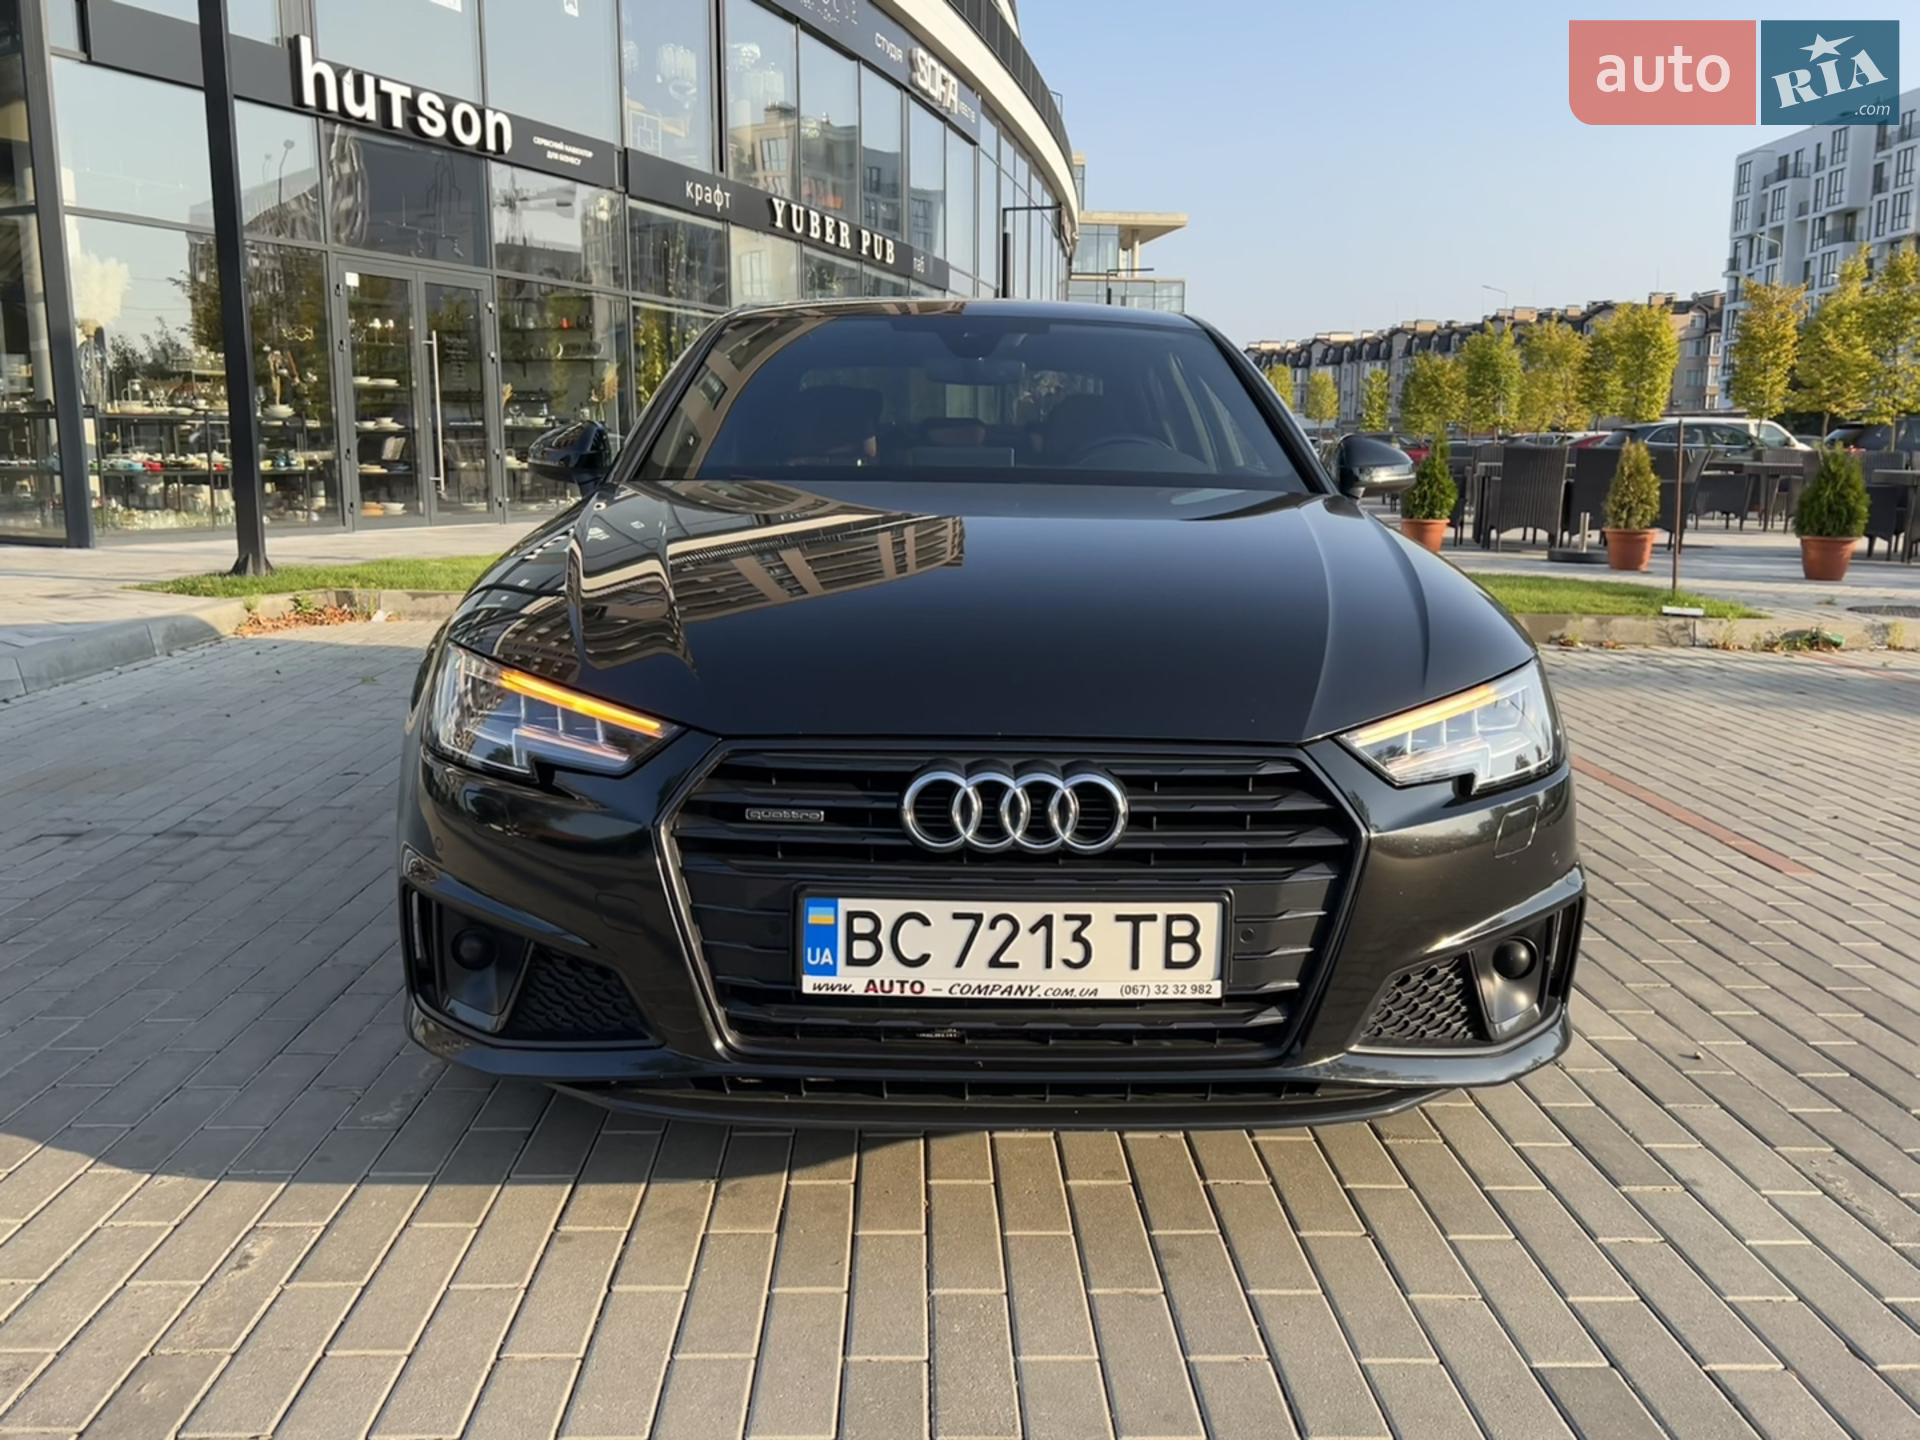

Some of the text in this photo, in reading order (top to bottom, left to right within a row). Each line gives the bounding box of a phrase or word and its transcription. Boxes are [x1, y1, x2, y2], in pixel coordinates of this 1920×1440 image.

[912, 47, 959, 116] SOFA
[685, 180, 731, 213] крафт
[772, 197, 895, 265] YUBER PUB
[749, 810, 820, 820] quattro
[807, 947, 834, 966] UA
[845, 910, 1202, 970] BC 7213 TB
[863, 979, 926, 995] AUTO
[1119, 984, 1151, 997] (067)
[1154, 984, 1169, 996] 32
[1172, 984, 1188, 996] 32
[1190, 984, 1213, 996] 982
